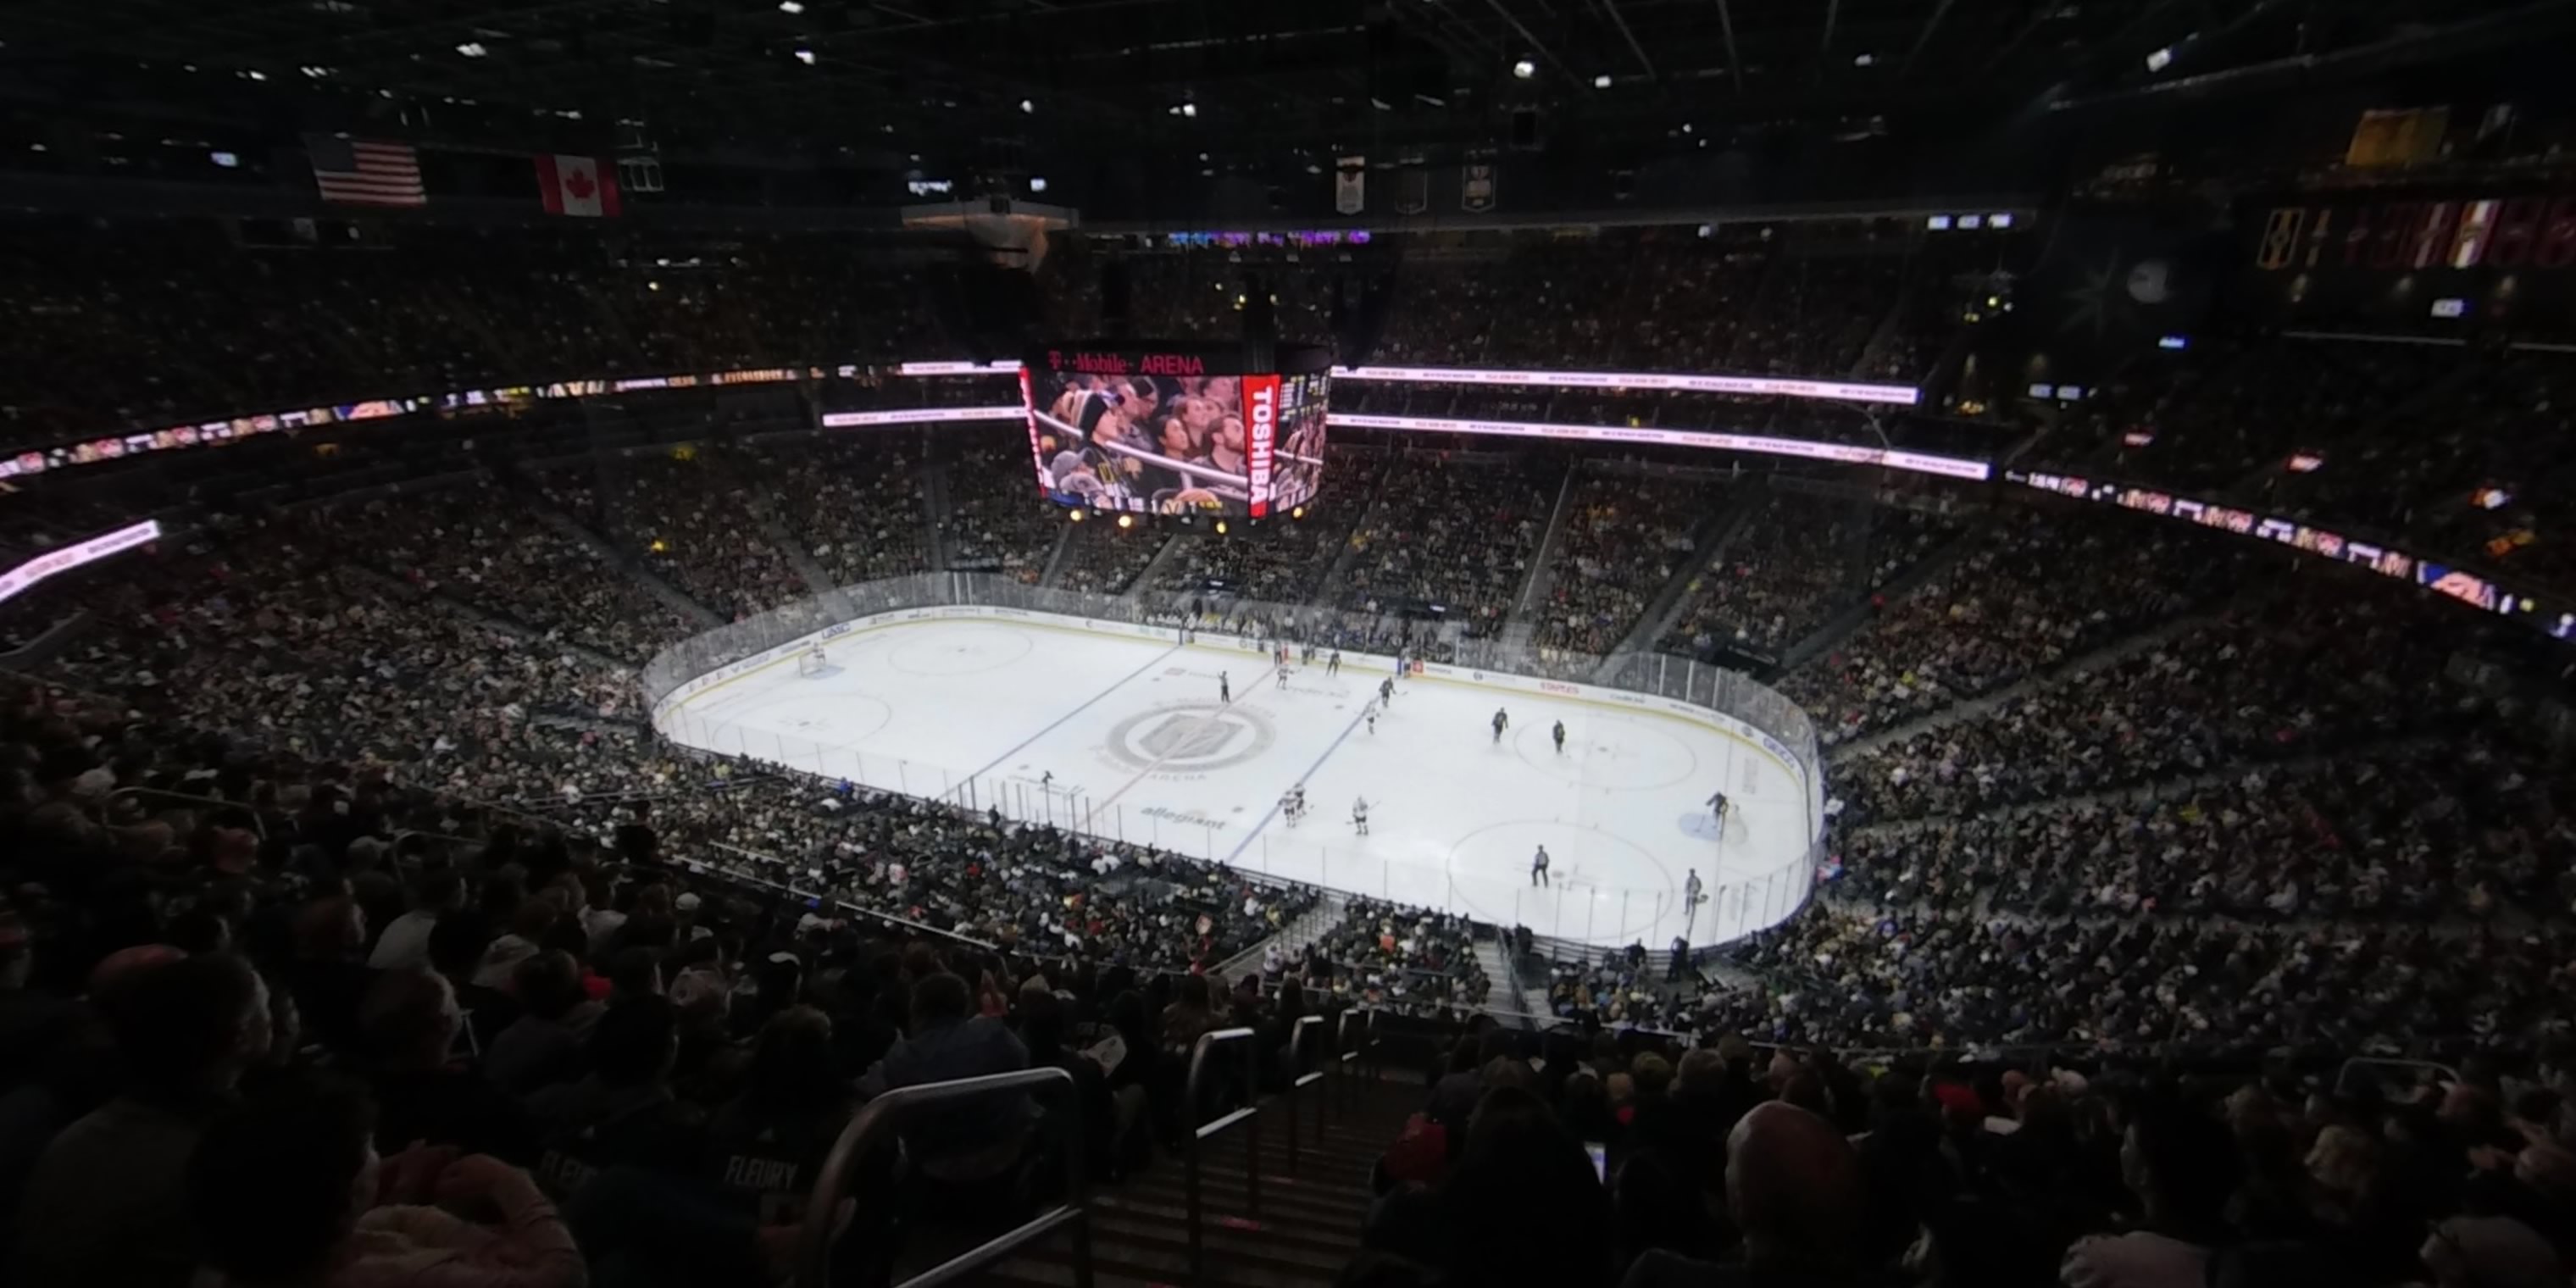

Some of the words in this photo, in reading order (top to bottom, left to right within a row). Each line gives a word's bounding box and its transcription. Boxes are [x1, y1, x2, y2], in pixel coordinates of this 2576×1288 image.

[1140, 354, 1205, 375] ARENA
[1250, 386, 1274, 505] TOSHIBA
[1140, 807, 1226, 830] allegiant
[723, 1154, 799, 1188] FLEURY
